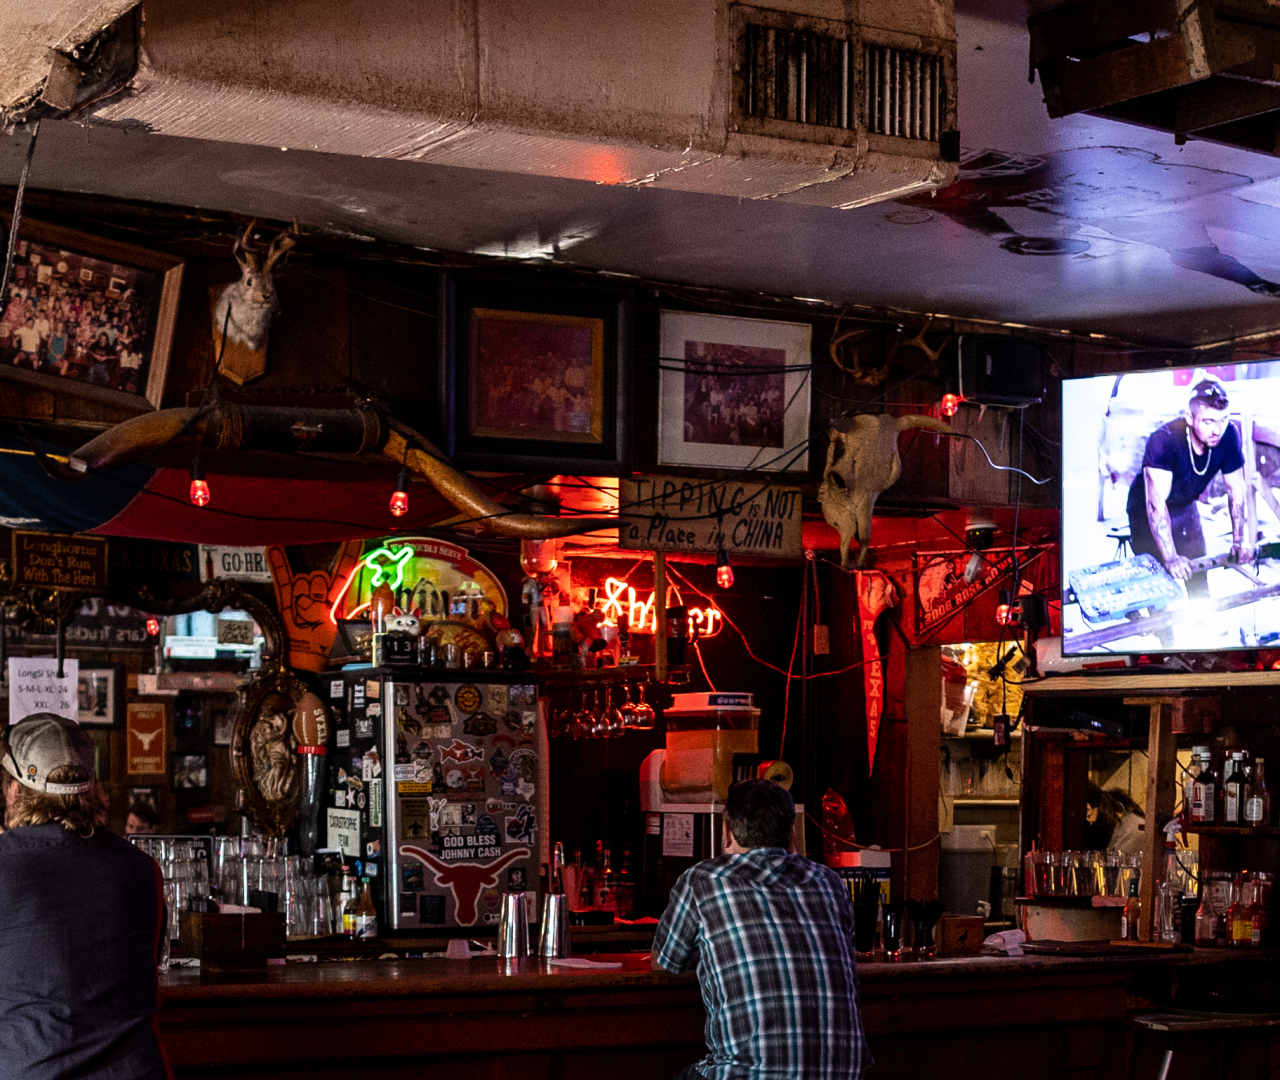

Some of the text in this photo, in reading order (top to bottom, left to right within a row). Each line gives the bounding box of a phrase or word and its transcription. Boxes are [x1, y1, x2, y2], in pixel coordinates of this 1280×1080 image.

[631, 479, 801, 520] TIPPING is NOT
[629, 522, 640, 540] a
[648, 513, 696, 544] Place
[732, 517, 784, 549] CHINA
[439, 846, 501, 860] JOHNNY CASH
[443, 834, 497, 847] GOD BLESS
